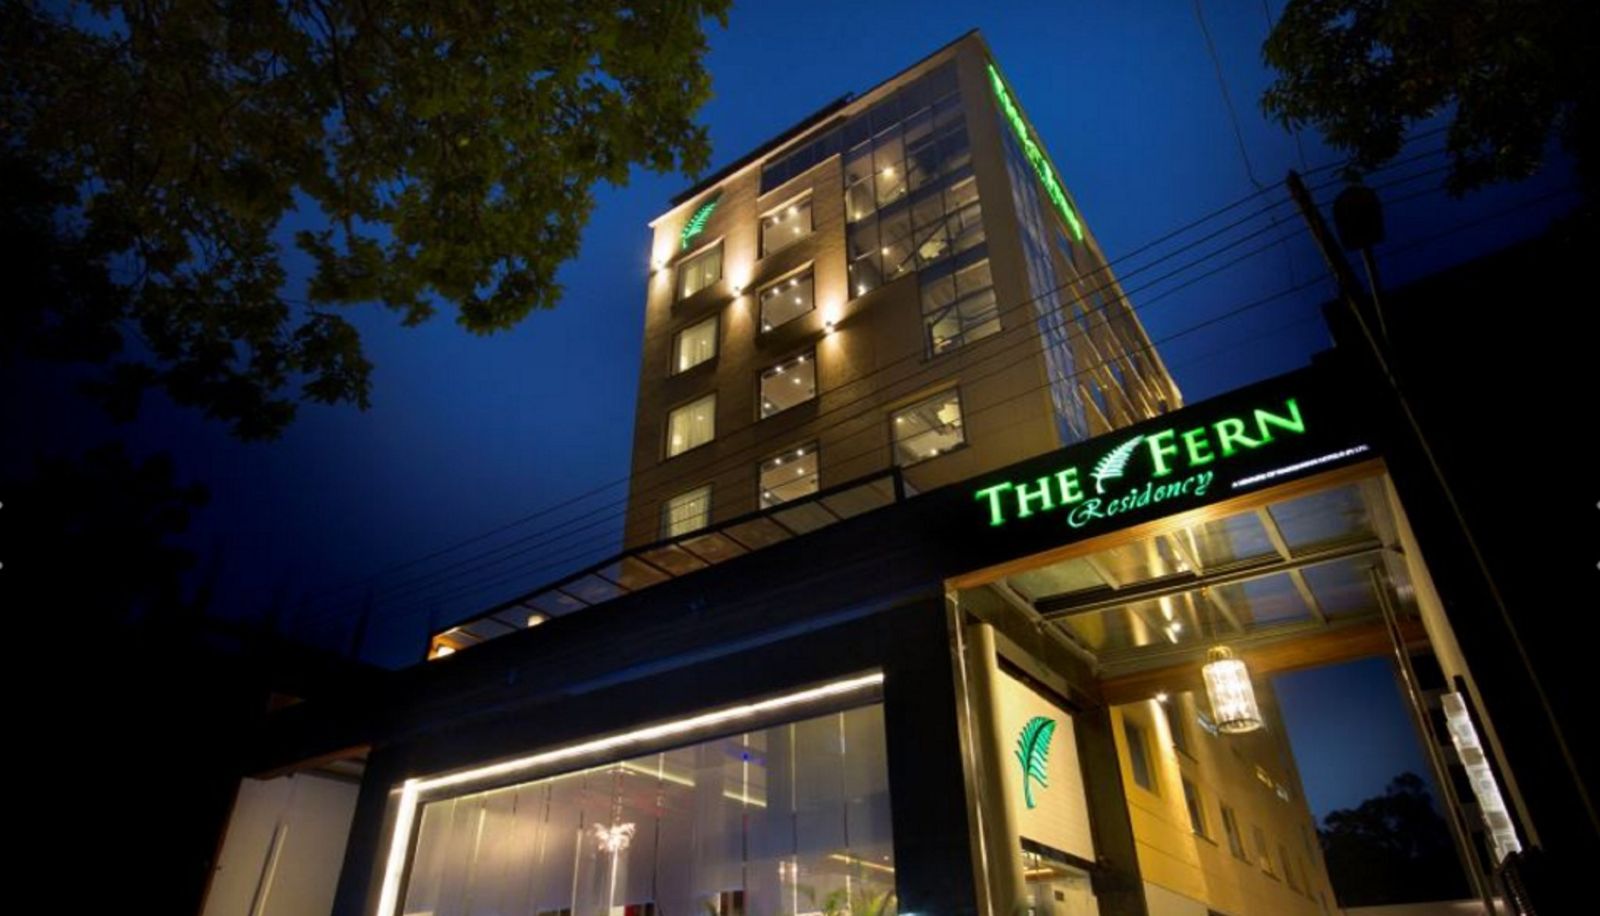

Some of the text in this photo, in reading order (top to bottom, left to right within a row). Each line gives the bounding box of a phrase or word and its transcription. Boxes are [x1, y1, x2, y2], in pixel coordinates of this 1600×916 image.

[976, 467, 1083, 527] THE
[1145, 399, 1306, 476] FERN
[1067, 470, 1213, 528] Residency
